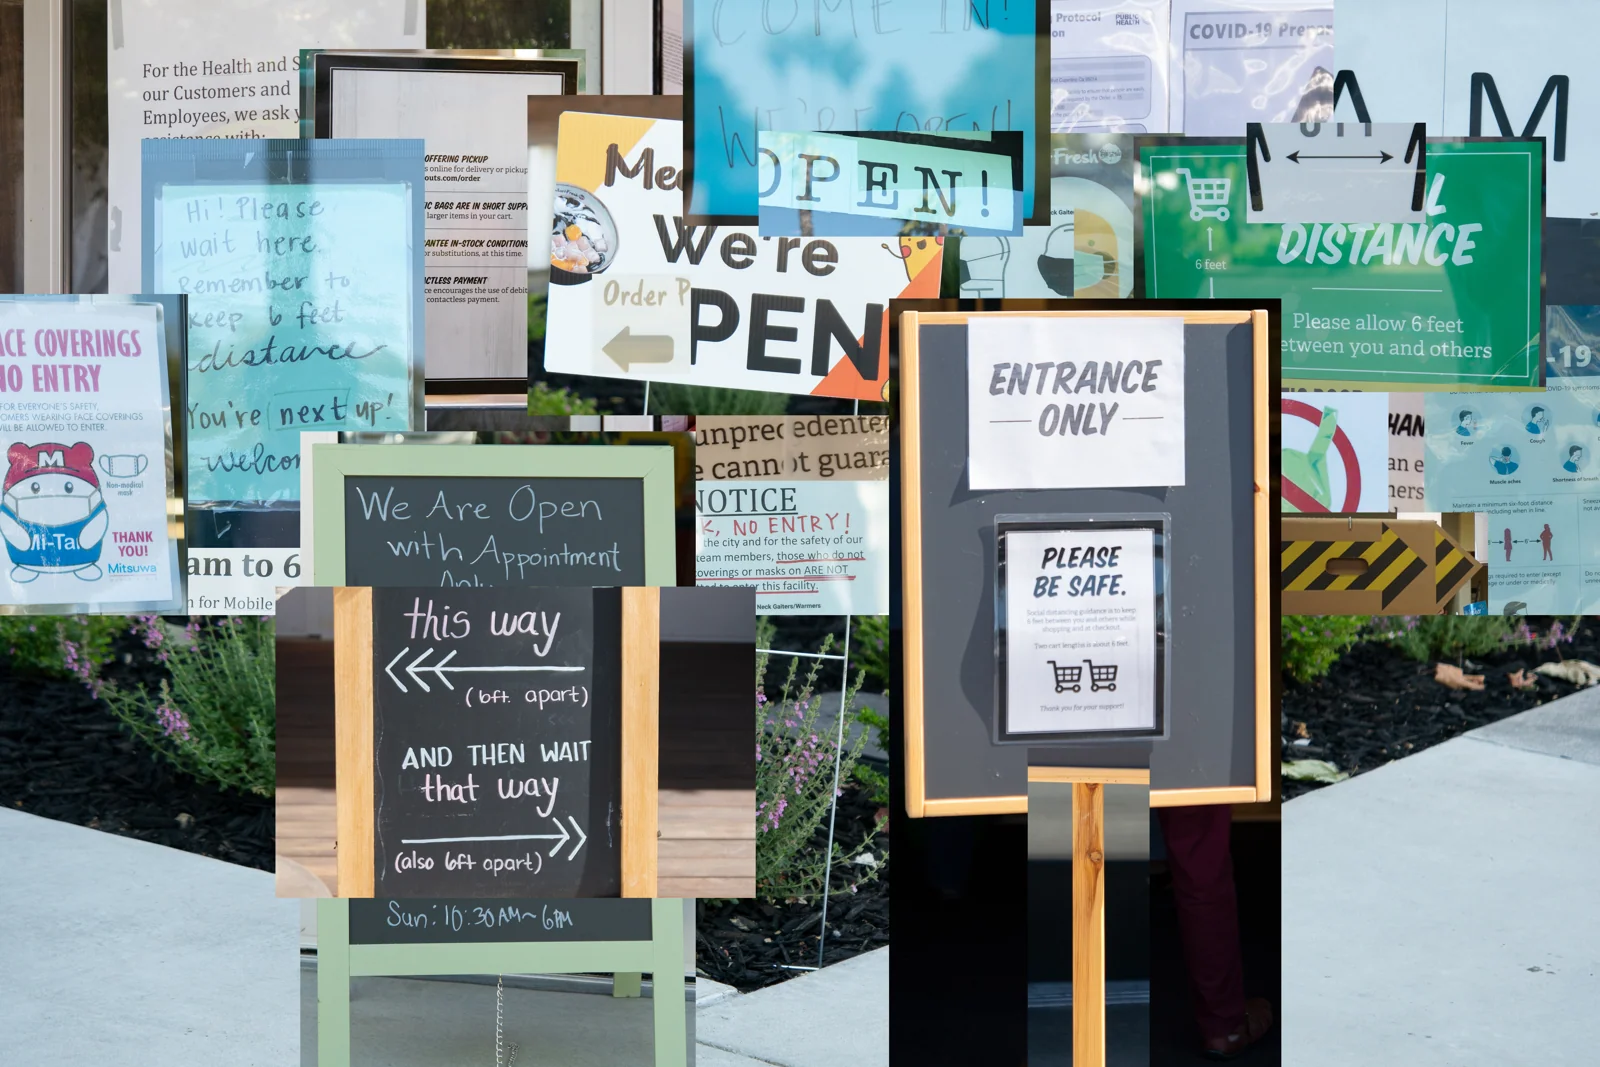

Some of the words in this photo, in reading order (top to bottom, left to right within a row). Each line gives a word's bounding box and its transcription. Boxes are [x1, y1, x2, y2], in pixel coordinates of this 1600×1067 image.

[1056, 12, 1101, 22] Protocol
[1190, 23, 1272, 39] COVID-19
[142, 63, 170, 78] For
[173, 62, 198, 77] the
[203, 58, 252, 76] Health
[257, 57, 286, 72] and
[143, 90, 170, 101] our
[174, 84, 255, 100] Customers
[261, 81, 290, 96] and
[144, 109, 230, 127] Employees,
[235, 109, 257, 122] we
[262, 105, 289, 120] ask
[462, 155, 488, 163] PICKUP
[1054, 148, 1099, 165] Fresh
[186, 197, 223, 223] Hi!
[236, 196, 324, 220] Please
[482, 202, 505, 210] SHORT
[652, 213, 839, 276] Were
[1276, 222, 1483, 266] DISTANCE
[1196, 259, 1202, 270] 6
[1204, 258, 1226, 270] feet
[325, 271, 350, 288] to
[604, 279, 667, 306] Order
[296, 300, 346, 329] feet
[1293, 312, 1350, 330] Please
[1355, 314, 1406, 331] allow
[1411, 316, 1422, 332] 6
[1426, 316, 1464, 334] feet
[34, 329, 141, 357] COVERINGS
[188, 335, 388, 372] distance
[1349, 344, 1384, 358] you
[1389, 340, 1425, 356] and
[1430, 340, 1492, 359] others
[32, 365, 101, 392] ENTRY
[989, 359, 1162, 396] ENTRANCE
[70, 403, 99, 411] SAFETY,
[188, 401, 261, 429] You're
[280, 396, 347, 425] next
[356, 393, 393, 426] up!
[1038, 402, 1119, 437] ONLY
[107, 481, 143, 489] Non-medical
[356, 486, 411, 521] We
[426, 490, 491, 521] Are
[509, 485, 602, 533] Open
[733, 520, 757, 536] NO
[769, 513, 850, 534] ENTRY!
[112, 531, 153, 543] THANK
[704, 538, 719, 547] the
[722, 537, 740, 548] city
[742, 537, 760, 546] and
[764, 537, 778, 545] for
[781, 537, 798, 545] the
[800, 536, 830, 546] safety
[833, 535, 843, 544] of
[846, 536, 863, 544] our
[118, 546, 148, 557] YOU!
[387, 531, 463, 561] with
[470, 535, 622, 580] Appointment
[696, 553, 721, 562] team
[724, 552, 774, 563] members,
[777, 551, 805, 560] those
[808, 551, 829, 560] who
[832, 550, 845, 559] do
[847, 551, 864, 559] not
[1041, 546, 1122, 570] PLEASE
[108, 563, 157, 573] Mitsuwa
[242, 555, 273, 577] to
[762, 581, 780, 591] this
[783, 580, 818, 592] facility.
[1033, 575, 1062, 598] BE
[1067, 574, 1126, 597] SAFE.
[199, 596, 219, 608] for
[224, 597, 273, 610] Mobile
[403, 597, 471, 641] this
[490, 610, 560, 657] way
[525, 686, 588, 710] apart)
[402, 746, 453, 770] AND
[467, 742, 525, 766] THEN
[540, 740, 592, 763] WAIT
[421, 773, 480, 804] that
[497, 777, 559, 818] way
[394, 850, 434, 873] (also
[445, 851, 476, 870] 6ft
[483, 852, 543, 876] apart)
[387, 900, 437, 929] Sun:
